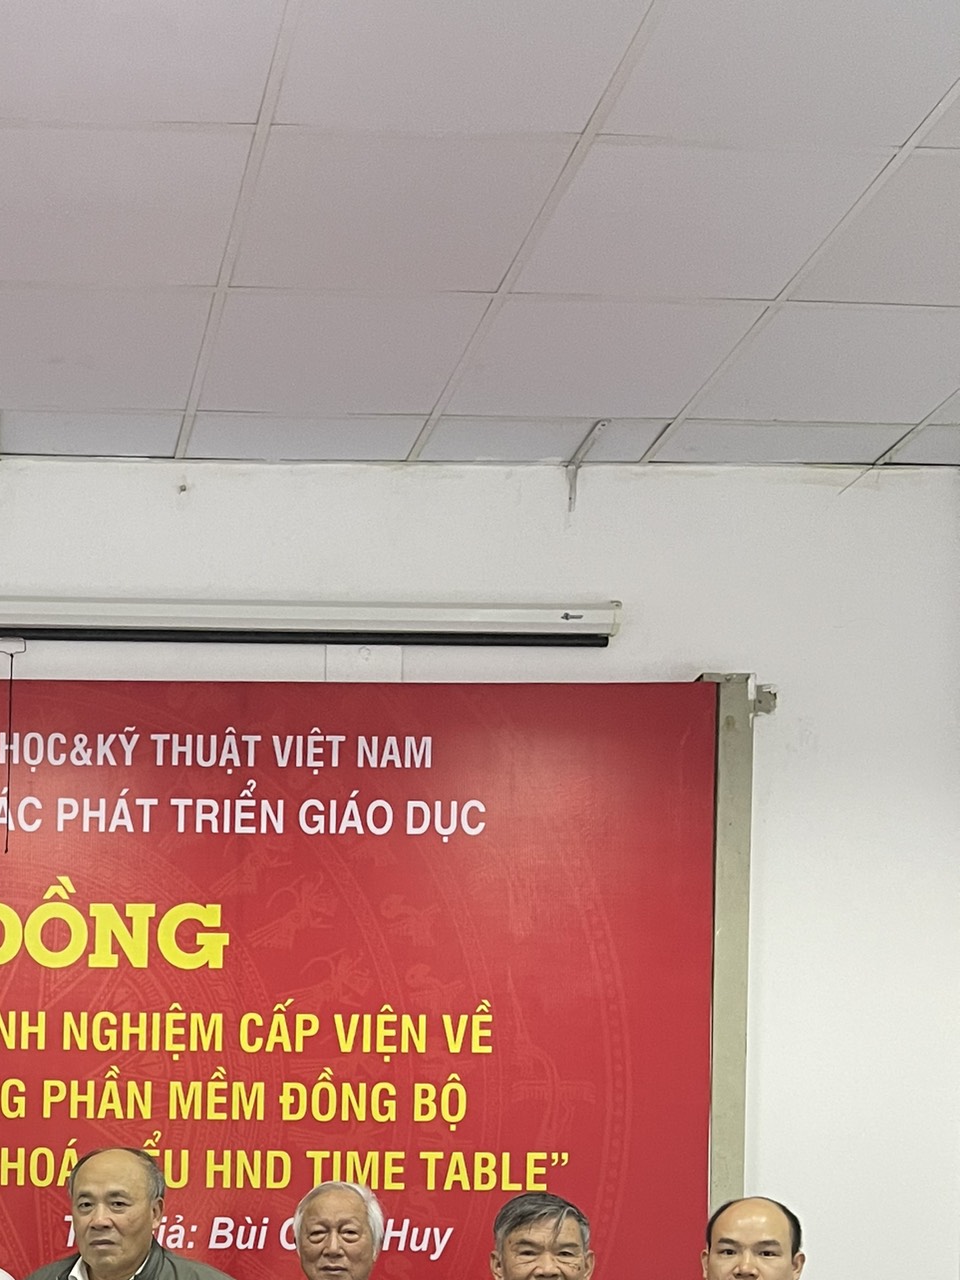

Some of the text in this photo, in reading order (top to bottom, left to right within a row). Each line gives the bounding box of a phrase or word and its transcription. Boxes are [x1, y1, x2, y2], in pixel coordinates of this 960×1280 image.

[150, 726, 262, 775] THUẬT
[272, 727, 346, 775] VIỆT
[357, 735, 432, 769] NAM
[56, 788, 159, 833] PHÁT
[169, 779, 284, 834] TRIỂN
[298, 789, 394, 836] GIÁO
[406, 799, 486, 843] DỤC
[62, 1002, 223, 1061] NGHIỆM
[239, 998, 320, 1053] CẤP
[333, 1004, 427, 1063] VIỆN
[442, 1000, 493, 1054] VỀ
[42, 1066, 153, 1120] PHẦN
[168, 1066, 265, 1121] MỀM
[278, 1066, 397, 1123] ĐỒNG
[413, 1072, 467, 1132] BỘ
[205, 1149, 292, 1189] HND
[305, 1150, 406, 1189] TIME
[153, 1214, 198, 1249] iả:
[208, 1216, 270, 1250] Bùi
[382, 1218, 454, 1261] Huy
